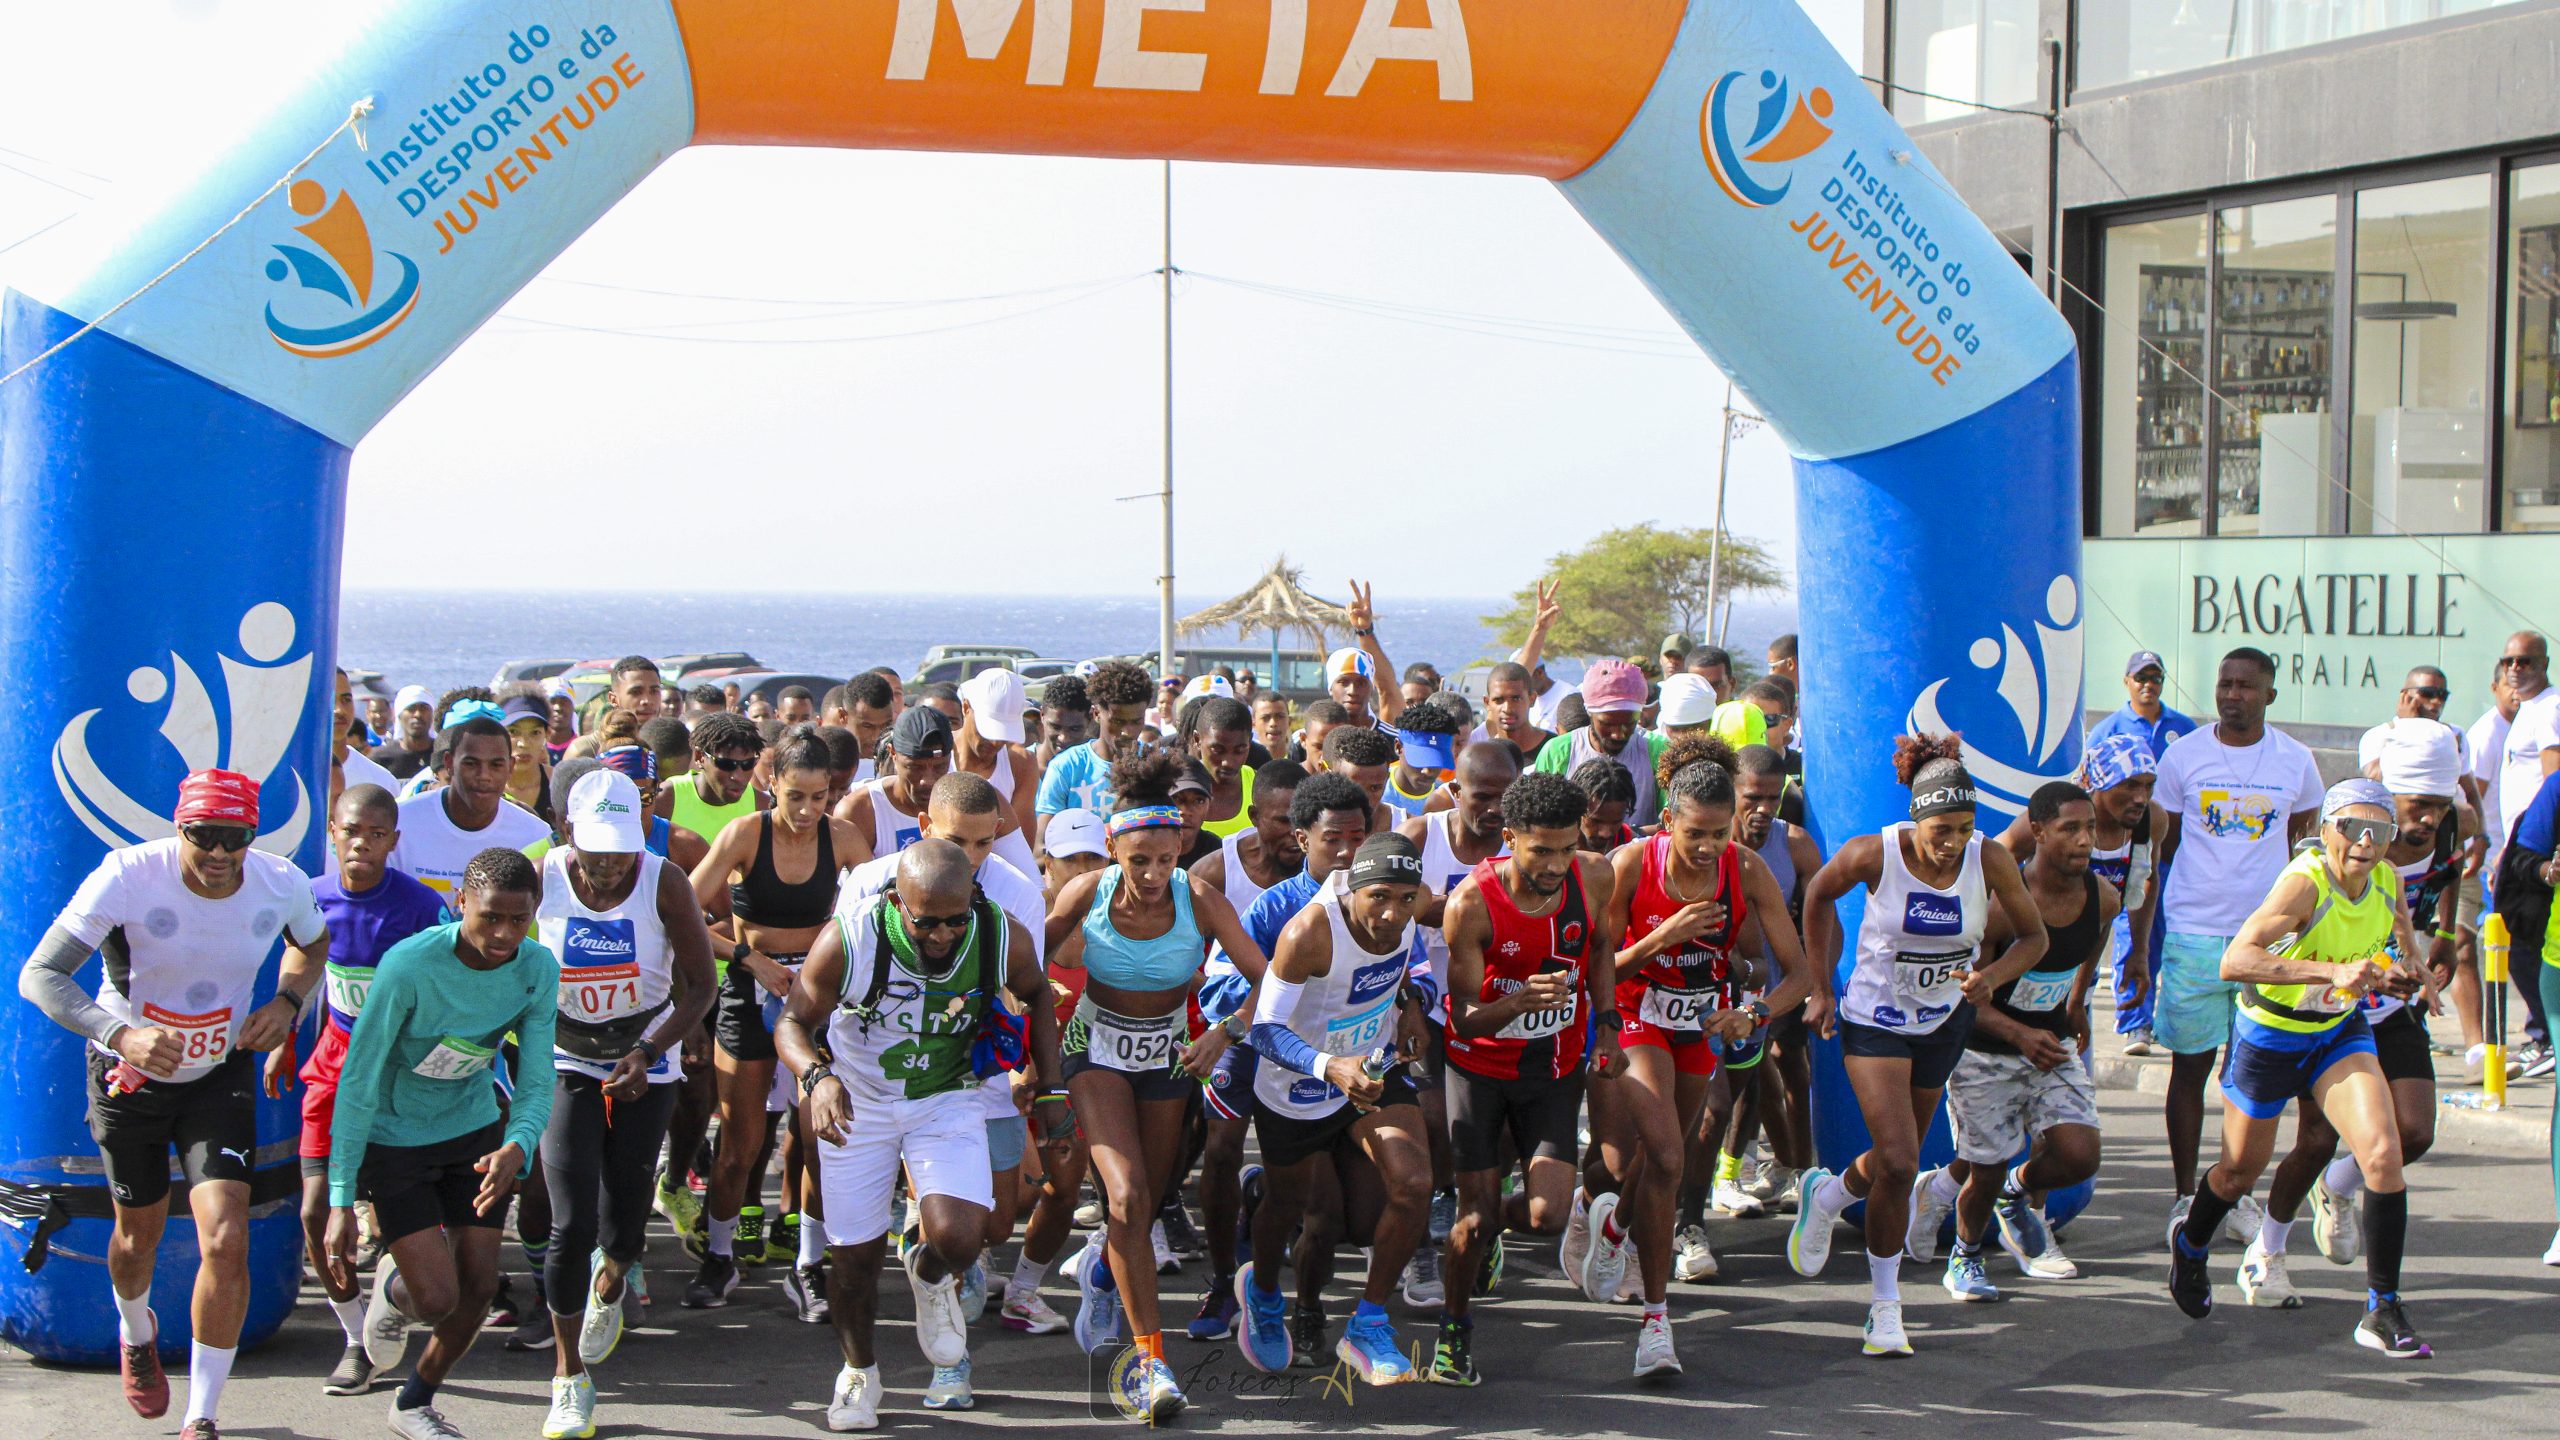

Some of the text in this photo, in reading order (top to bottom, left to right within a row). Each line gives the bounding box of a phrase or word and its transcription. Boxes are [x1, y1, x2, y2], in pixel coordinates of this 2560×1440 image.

[365, 24, 551, 186] Instituto do
[396, 24, 618, 218] DESPORTO e da
[432, 51, 646, 256] JUVENTUDE
[1841, 148, 1972, 298] Instituto do
[1820, 176, 1982, 356] DESPORTO e da
[1788, 210, 1962, 387] JUVENTUDE
[2190, 573, 2467, 638] BAGATELLE
[1914, 790, 1945, 810] TGC
[1909, 901, 1960, 924] Emicela
[568, 927, 632, 955] Emicela
[335, 980, 377, 1009] 10
[580, 981, 637, 1015] 071
[1493, 977, 1524, 994] PEDR
[1523, 999, 1574, 1031] 006
[1666, 994, 1715, 1021] 05
[902, 1053, 930, 1071] 34
[1117, 1034, 1169, 1062] 052
